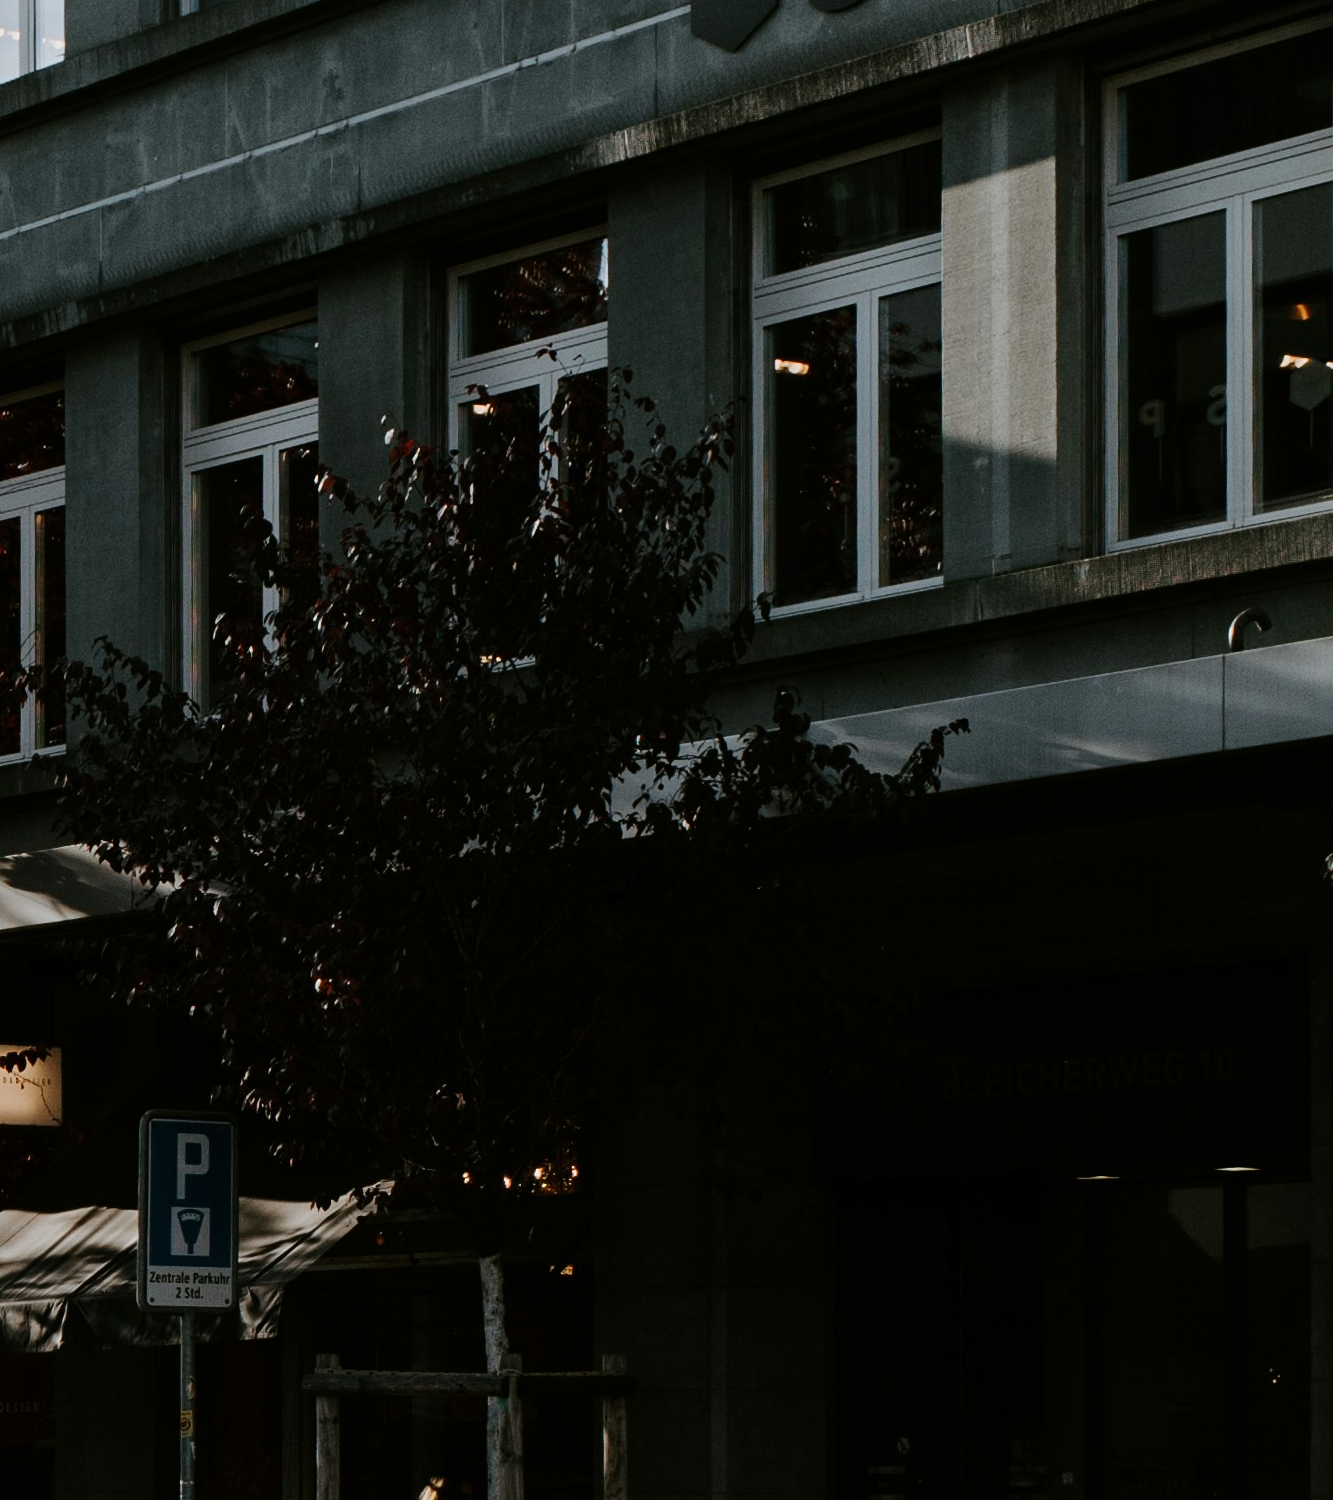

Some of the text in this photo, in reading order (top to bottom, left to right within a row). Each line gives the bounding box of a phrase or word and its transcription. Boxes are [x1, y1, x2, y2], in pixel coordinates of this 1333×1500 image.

[941, 1047, 1234, 1100] BLEICHERWEG 10
[177, 1133, 210, 1200] P
[149, 1271, 230, 1285] Zentrale Parkuhr
[175, 1287, 204, 1299] 2 Std.
